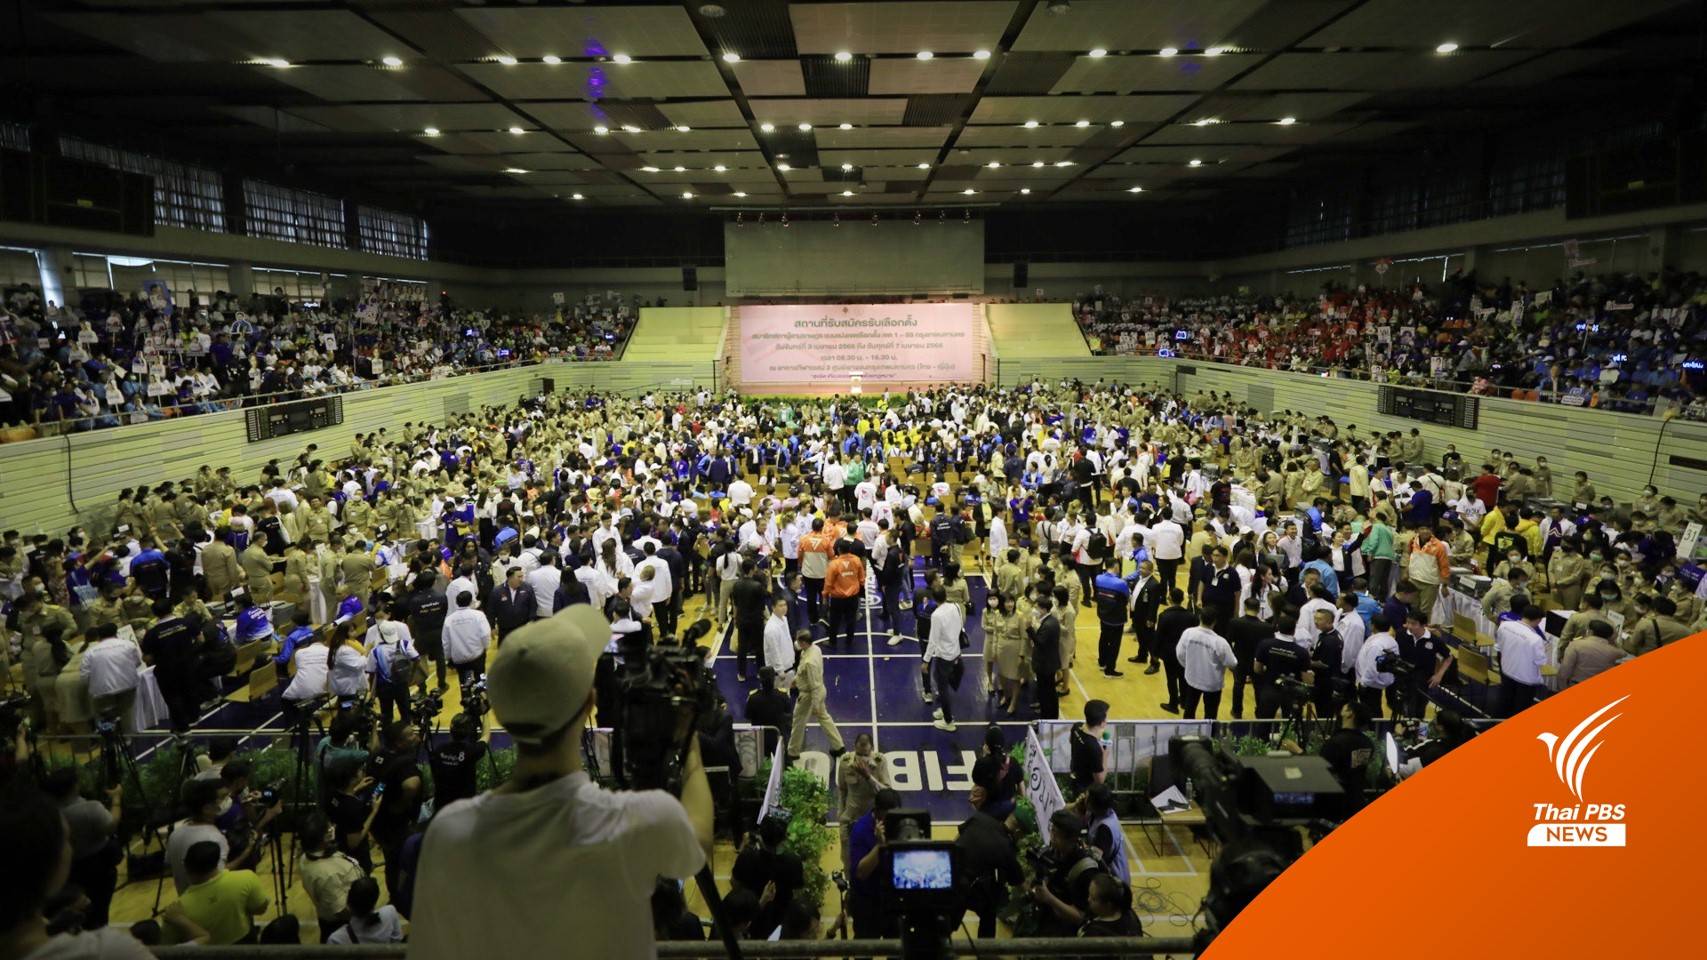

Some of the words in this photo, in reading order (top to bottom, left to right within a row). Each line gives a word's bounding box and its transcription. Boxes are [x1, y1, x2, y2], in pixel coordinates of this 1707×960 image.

[794, 315, 918, 327] สถานที่รับสมัครรับเลือกตั้ง
